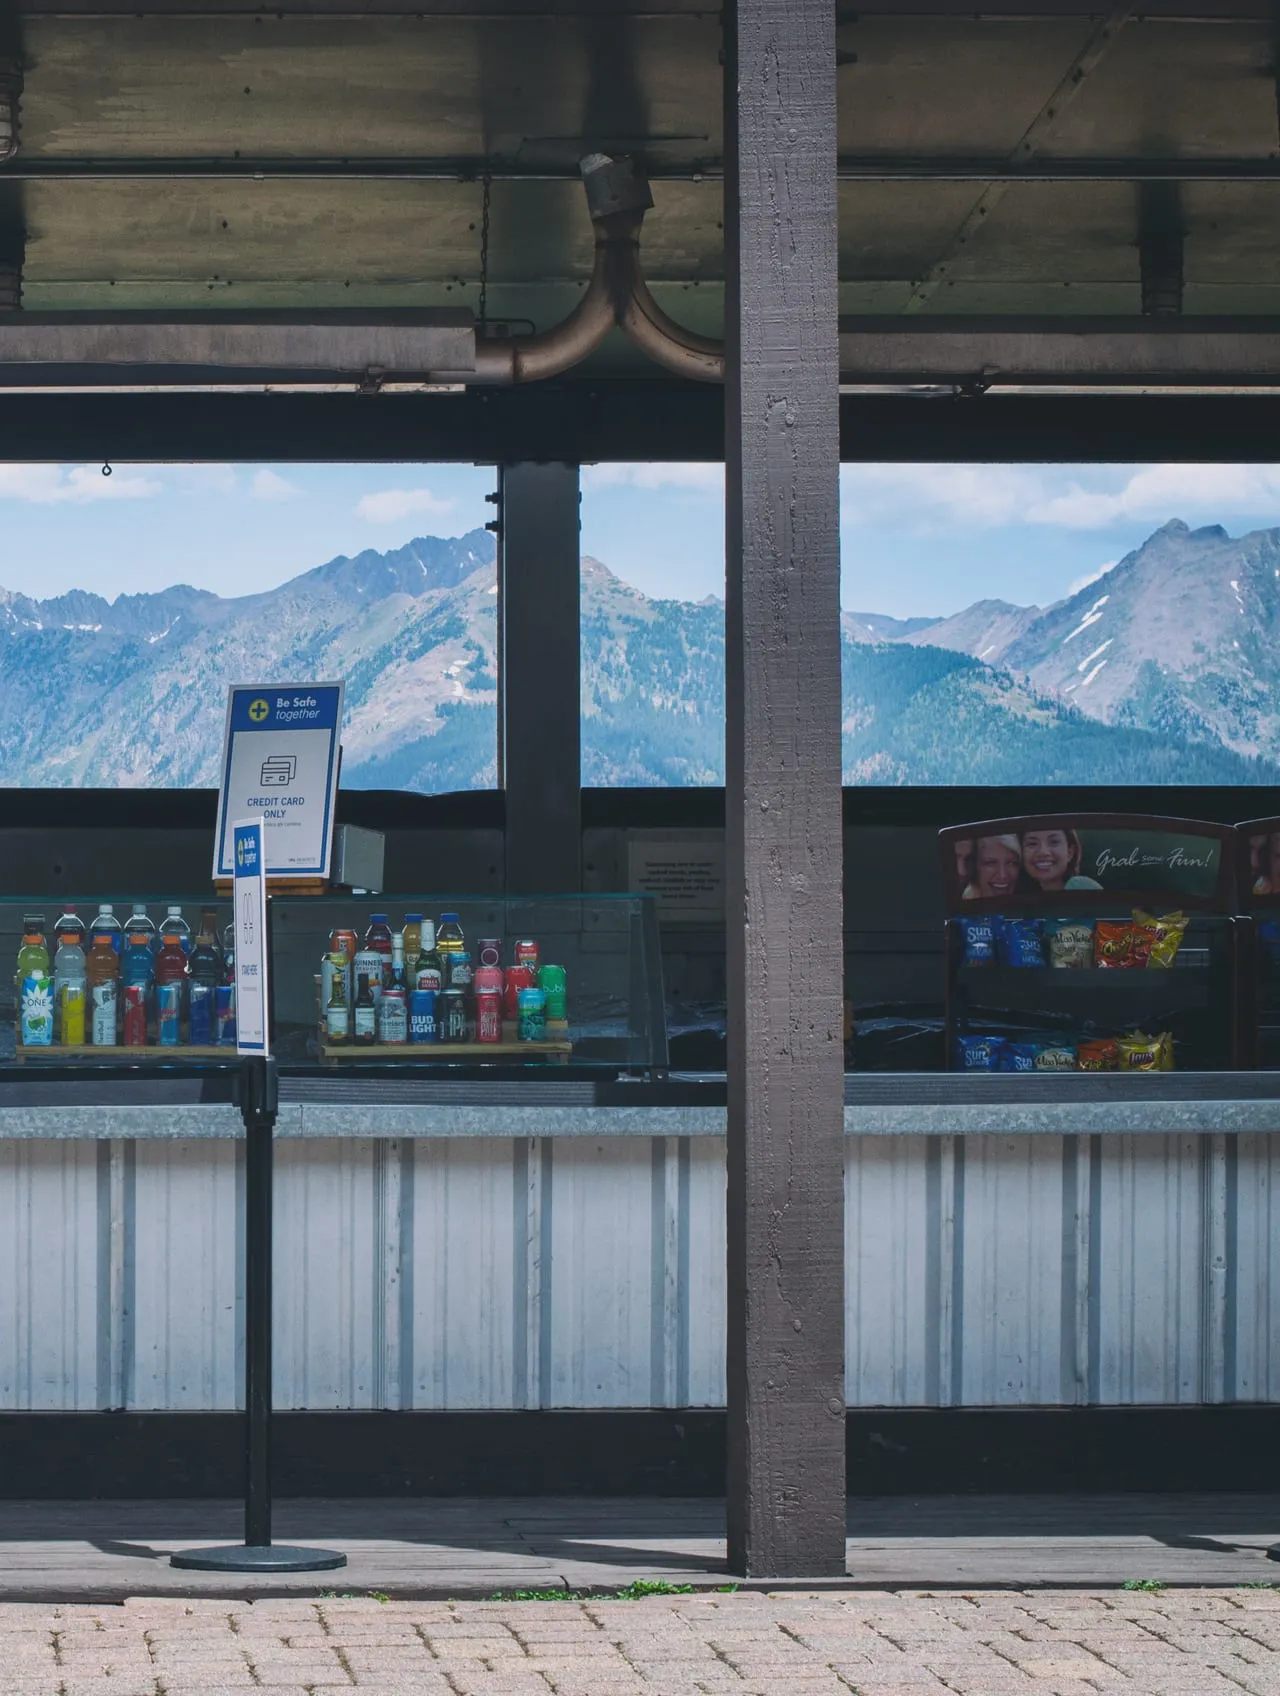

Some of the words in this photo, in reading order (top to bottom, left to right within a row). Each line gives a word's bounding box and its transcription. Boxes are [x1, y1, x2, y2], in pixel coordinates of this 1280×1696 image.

[276, 698, 290, 708] Be
[293, 696, 316, 707] Safe
[276, 709, 320, 722] together
[248, 797, 279, 806] CREDIT
[280, 797, 304, 806] CARD
[264, 810, 286, 819] ONLY
[1096, 847, 1139, 876] Grab
[1166, 847, 1213, 869] Fun!
[967, 926, 992, 942] Sun
[27, 998, 47, 1006] ONE
[411, 1016, 433, 1024] BUD
[409, 1024, 436, 1033] LIGHT
